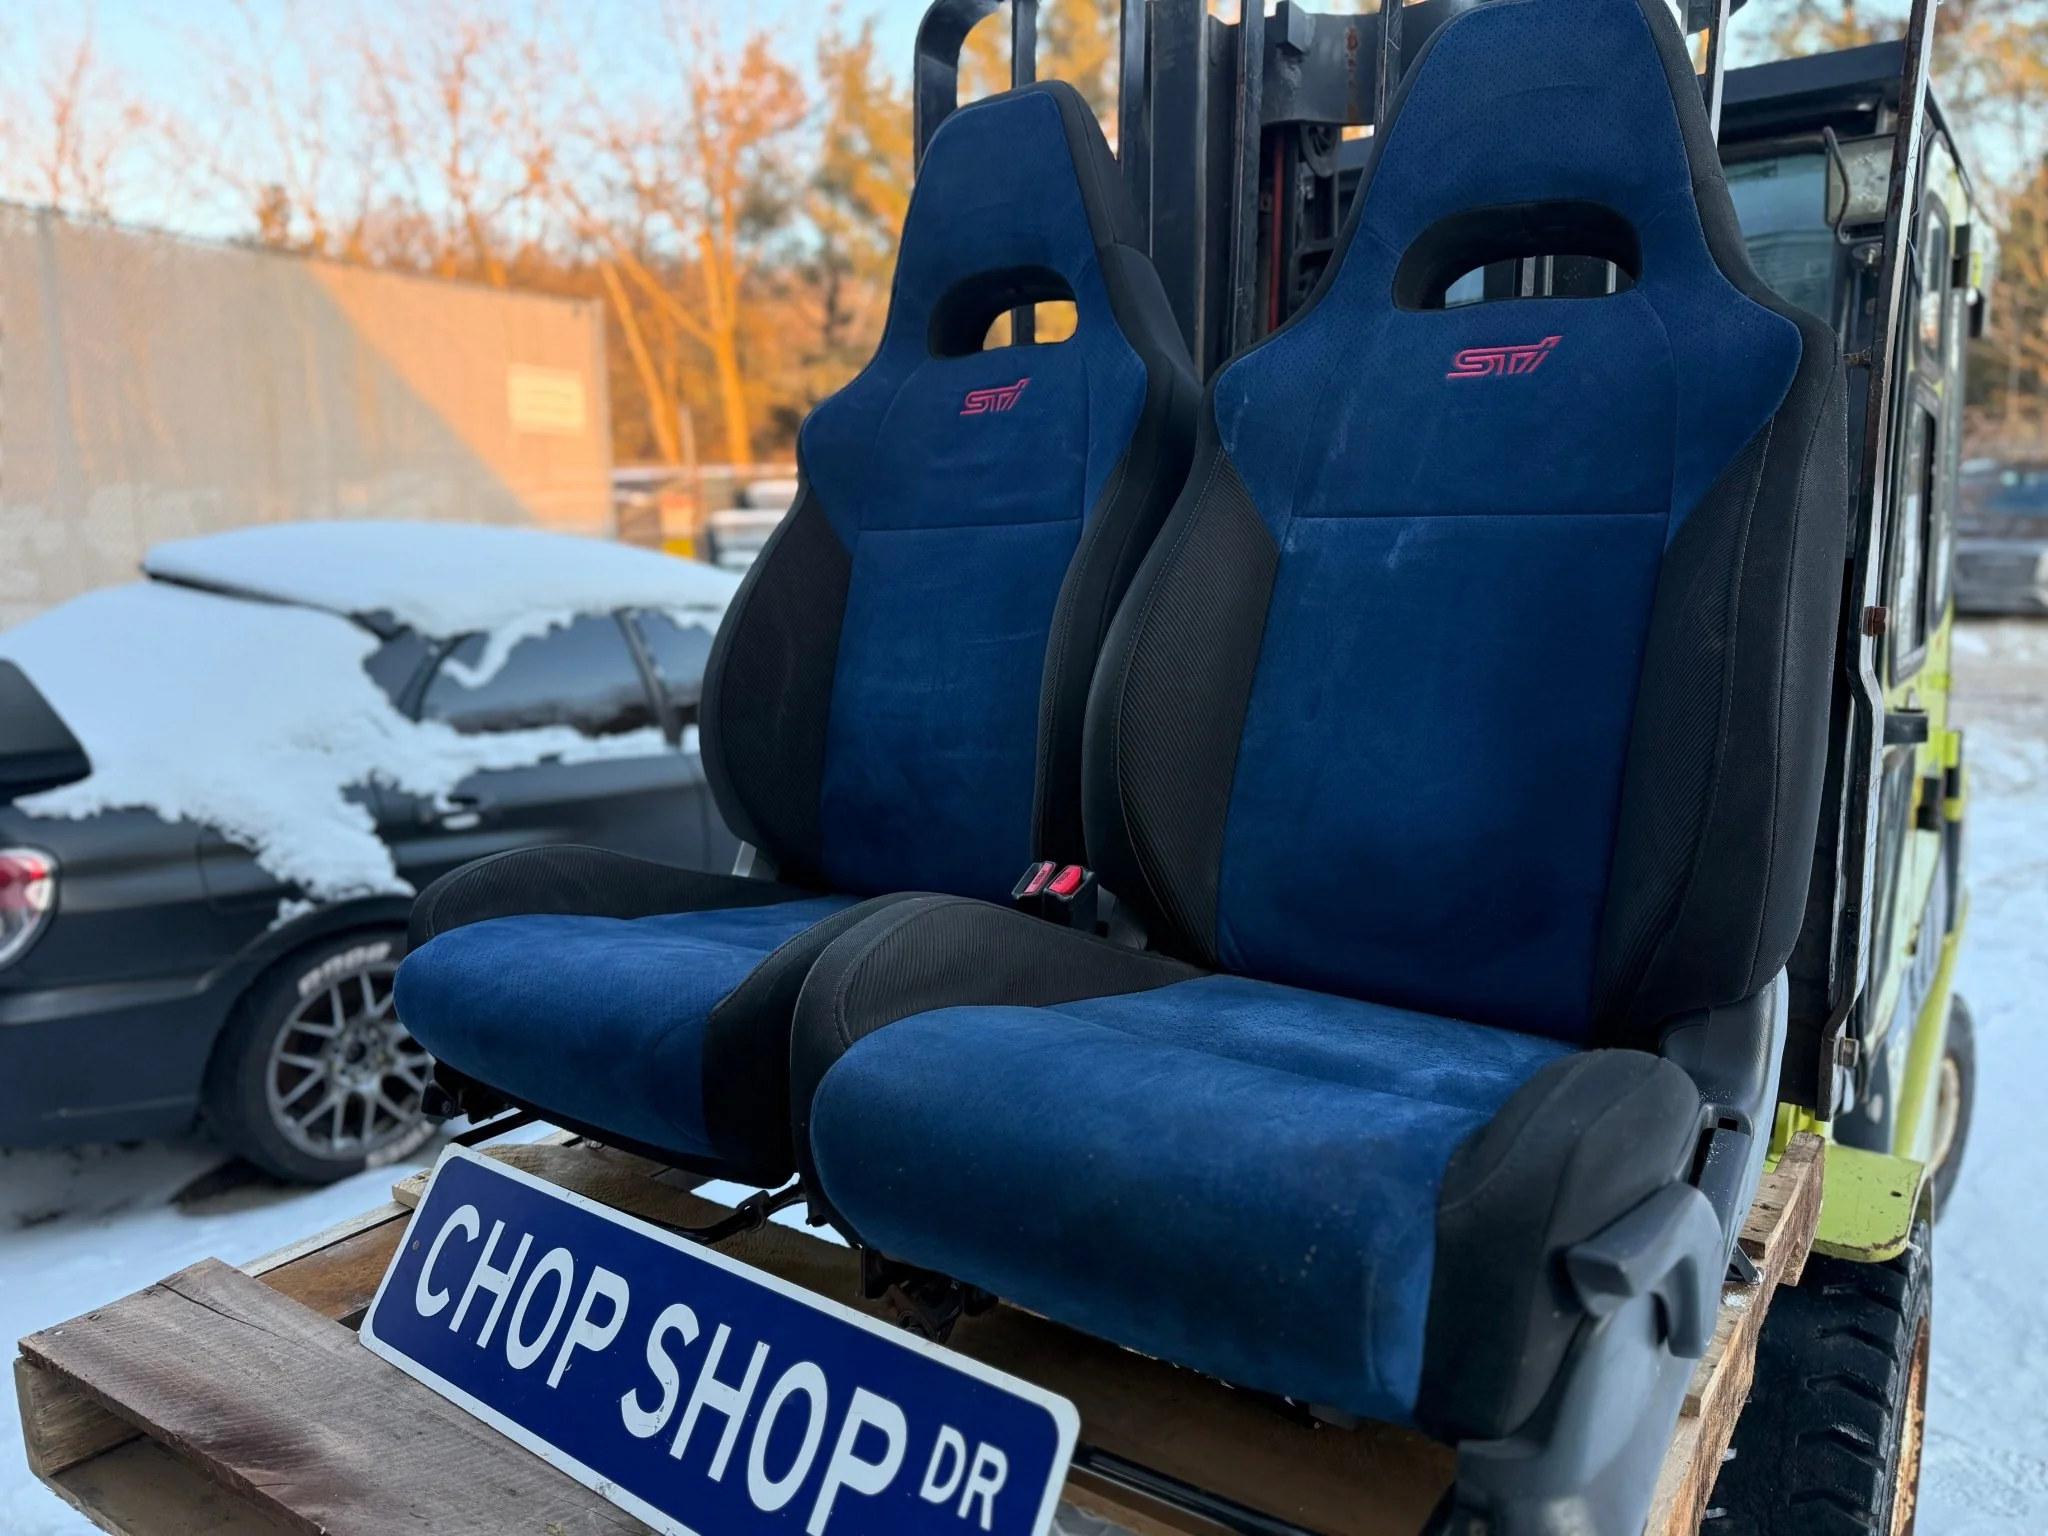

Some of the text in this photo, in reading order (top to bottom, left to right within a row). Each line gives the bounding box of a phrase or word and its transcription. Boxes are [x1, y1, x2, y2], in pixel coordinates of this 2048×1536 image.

[415, 1205, 1008, 1536] CHOP SHOP DR
